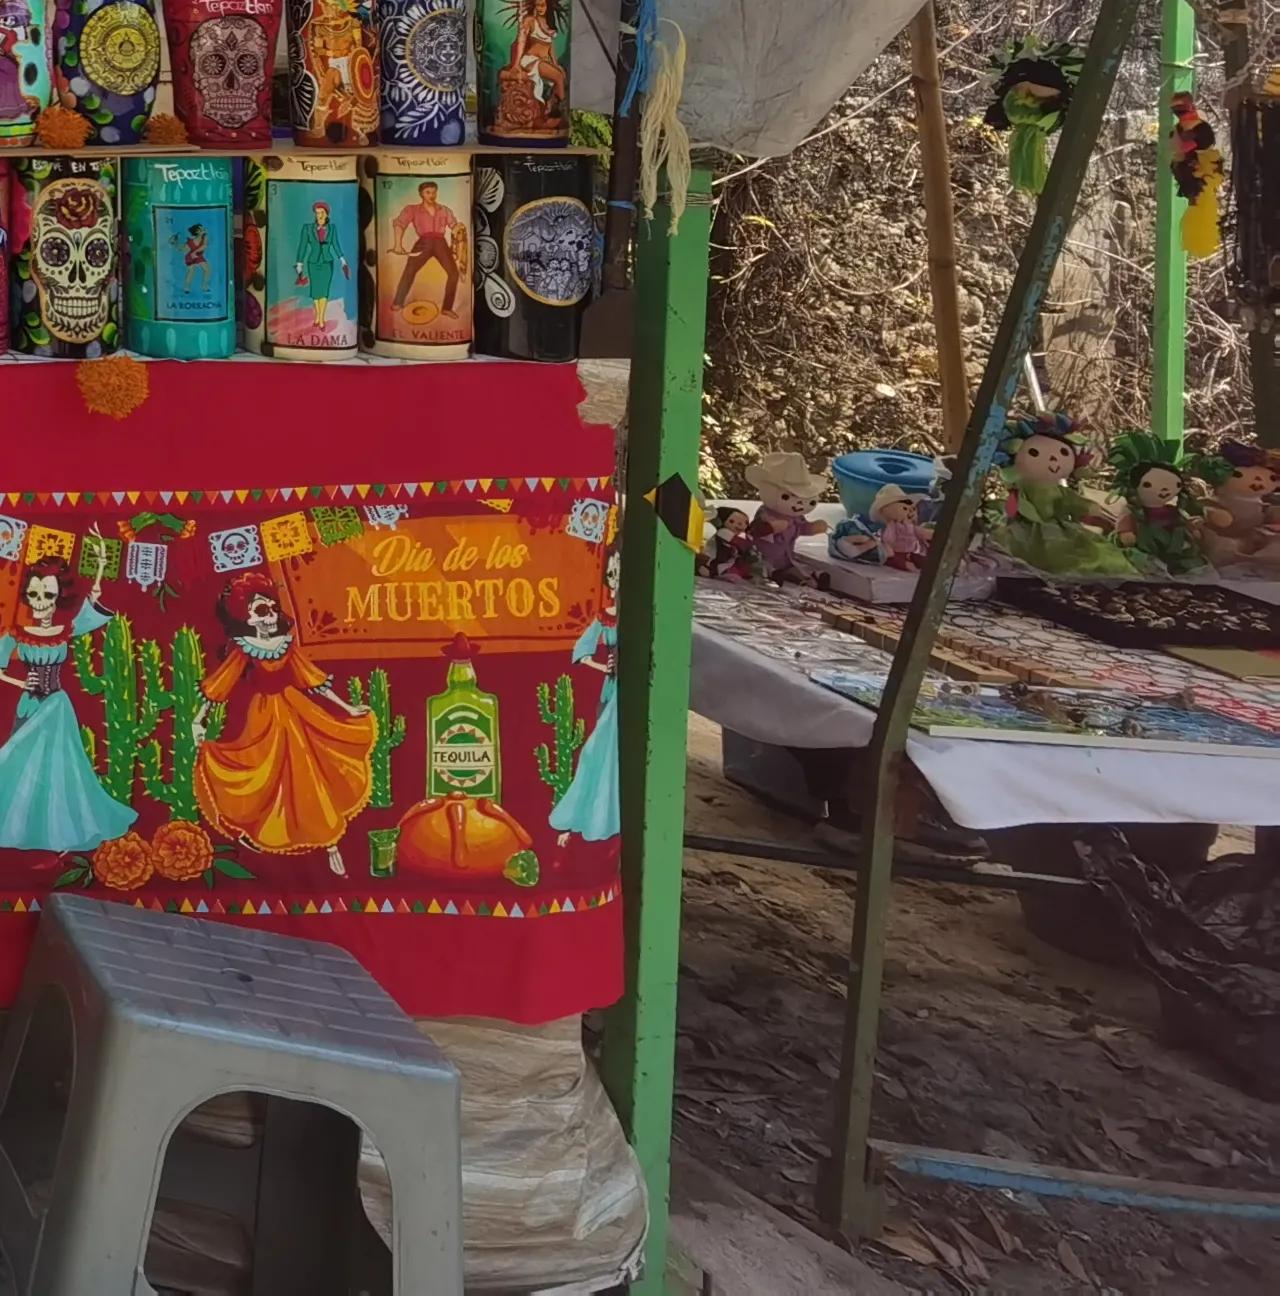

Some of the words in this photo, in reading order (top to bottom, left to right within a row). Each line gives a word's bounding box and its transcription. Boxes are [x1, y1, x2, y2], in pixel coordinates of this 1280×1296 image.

[287, 333, 305, 346] LA
[310, 333, 349, 347] DAMA
[411, 329, 466, 340] VALIENTE
[443, 536, 478, 570] de
[486, 533, 530, 569] los
[344, 576, 562, 624] MUERTOS
[433, 750, 491, 766] TEQUILA
